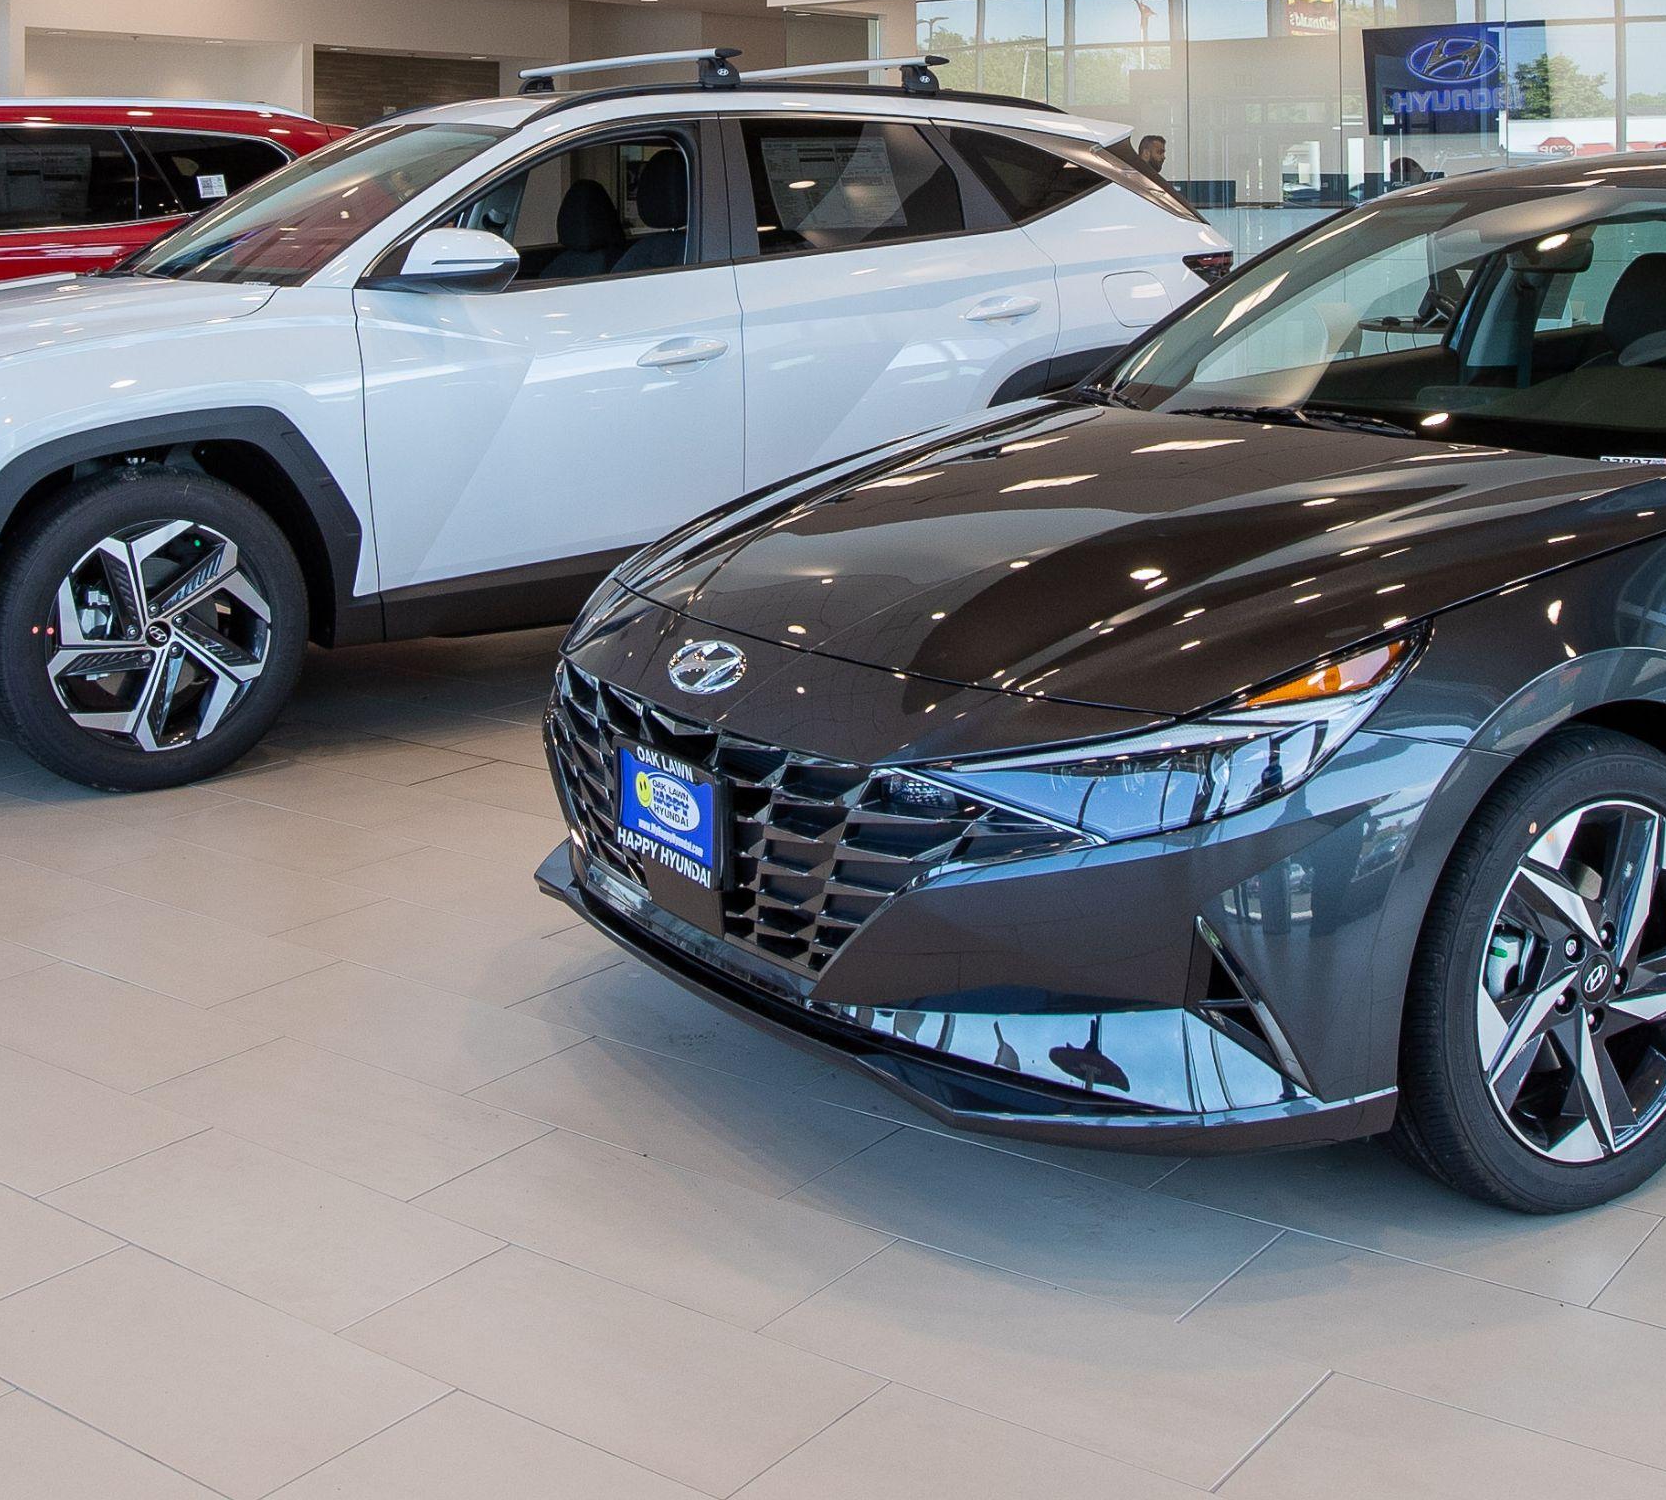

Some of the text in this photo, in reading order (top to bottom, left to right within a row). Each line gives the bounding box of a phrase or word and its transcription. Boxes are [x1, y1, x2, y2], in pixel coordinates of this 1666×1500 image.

[636, 745, 694, 783] OAK LAWN
[652, 779, 689, 801] OAK LAWN
[653, 803, 689, 828] HYUNDAI
[617, 826, 711, 890] HAPPY HYUNDAI
